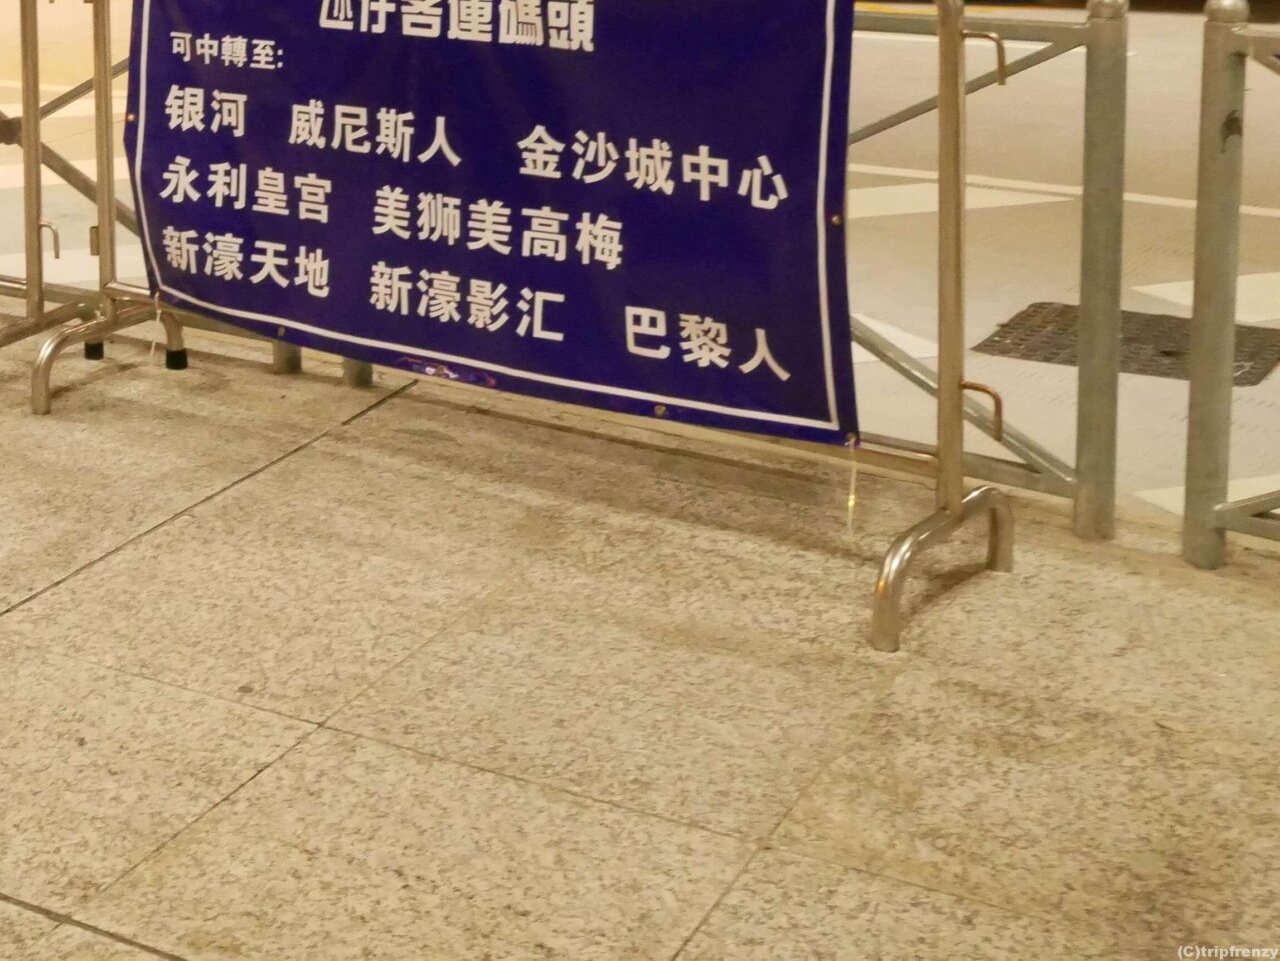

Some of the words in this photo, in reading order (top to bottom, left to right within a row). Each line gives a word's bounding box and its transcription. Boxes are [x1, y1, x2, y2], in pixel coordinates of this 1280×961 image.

[165, 85, 247, 137] 银河
[289, 99, 461, 166] 威尼斯人
[517, 125, 787, 209] 金沙城中心
[372, 185, 623, 270] 美狮美高梅
[163, 226, 329, 297] 新濠天地
[370, 261, 564, 341] 新濠影汇
[626, 306, 790, 380] 巴黎人
